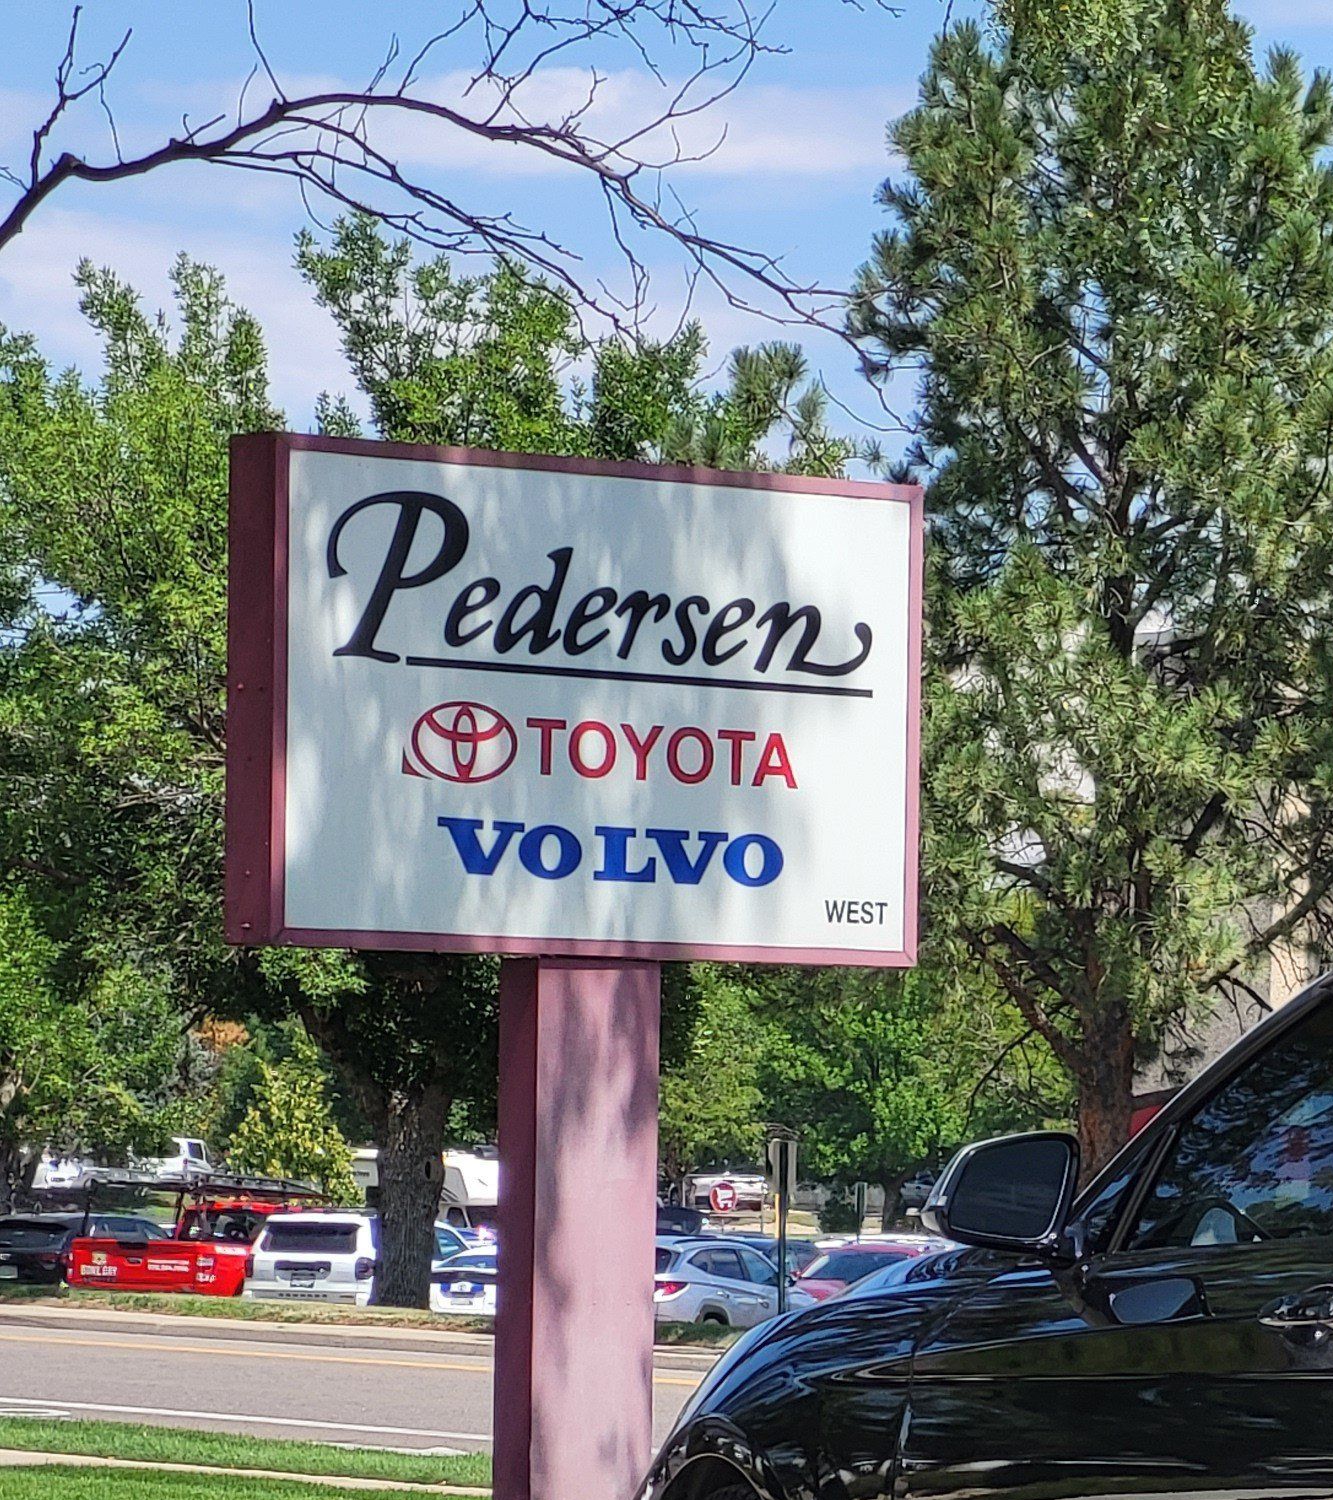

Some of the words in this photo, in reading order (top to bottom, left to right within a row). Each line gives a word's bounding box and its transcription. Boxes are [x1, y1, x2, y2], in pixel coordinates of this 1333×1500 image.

[326, 490, 873, 678] Pedersen
[526, 717, 798, 790] TOYOTA
[437, 816, 784, 887] VOLVO
[824, 899, 888, 926] WEST
